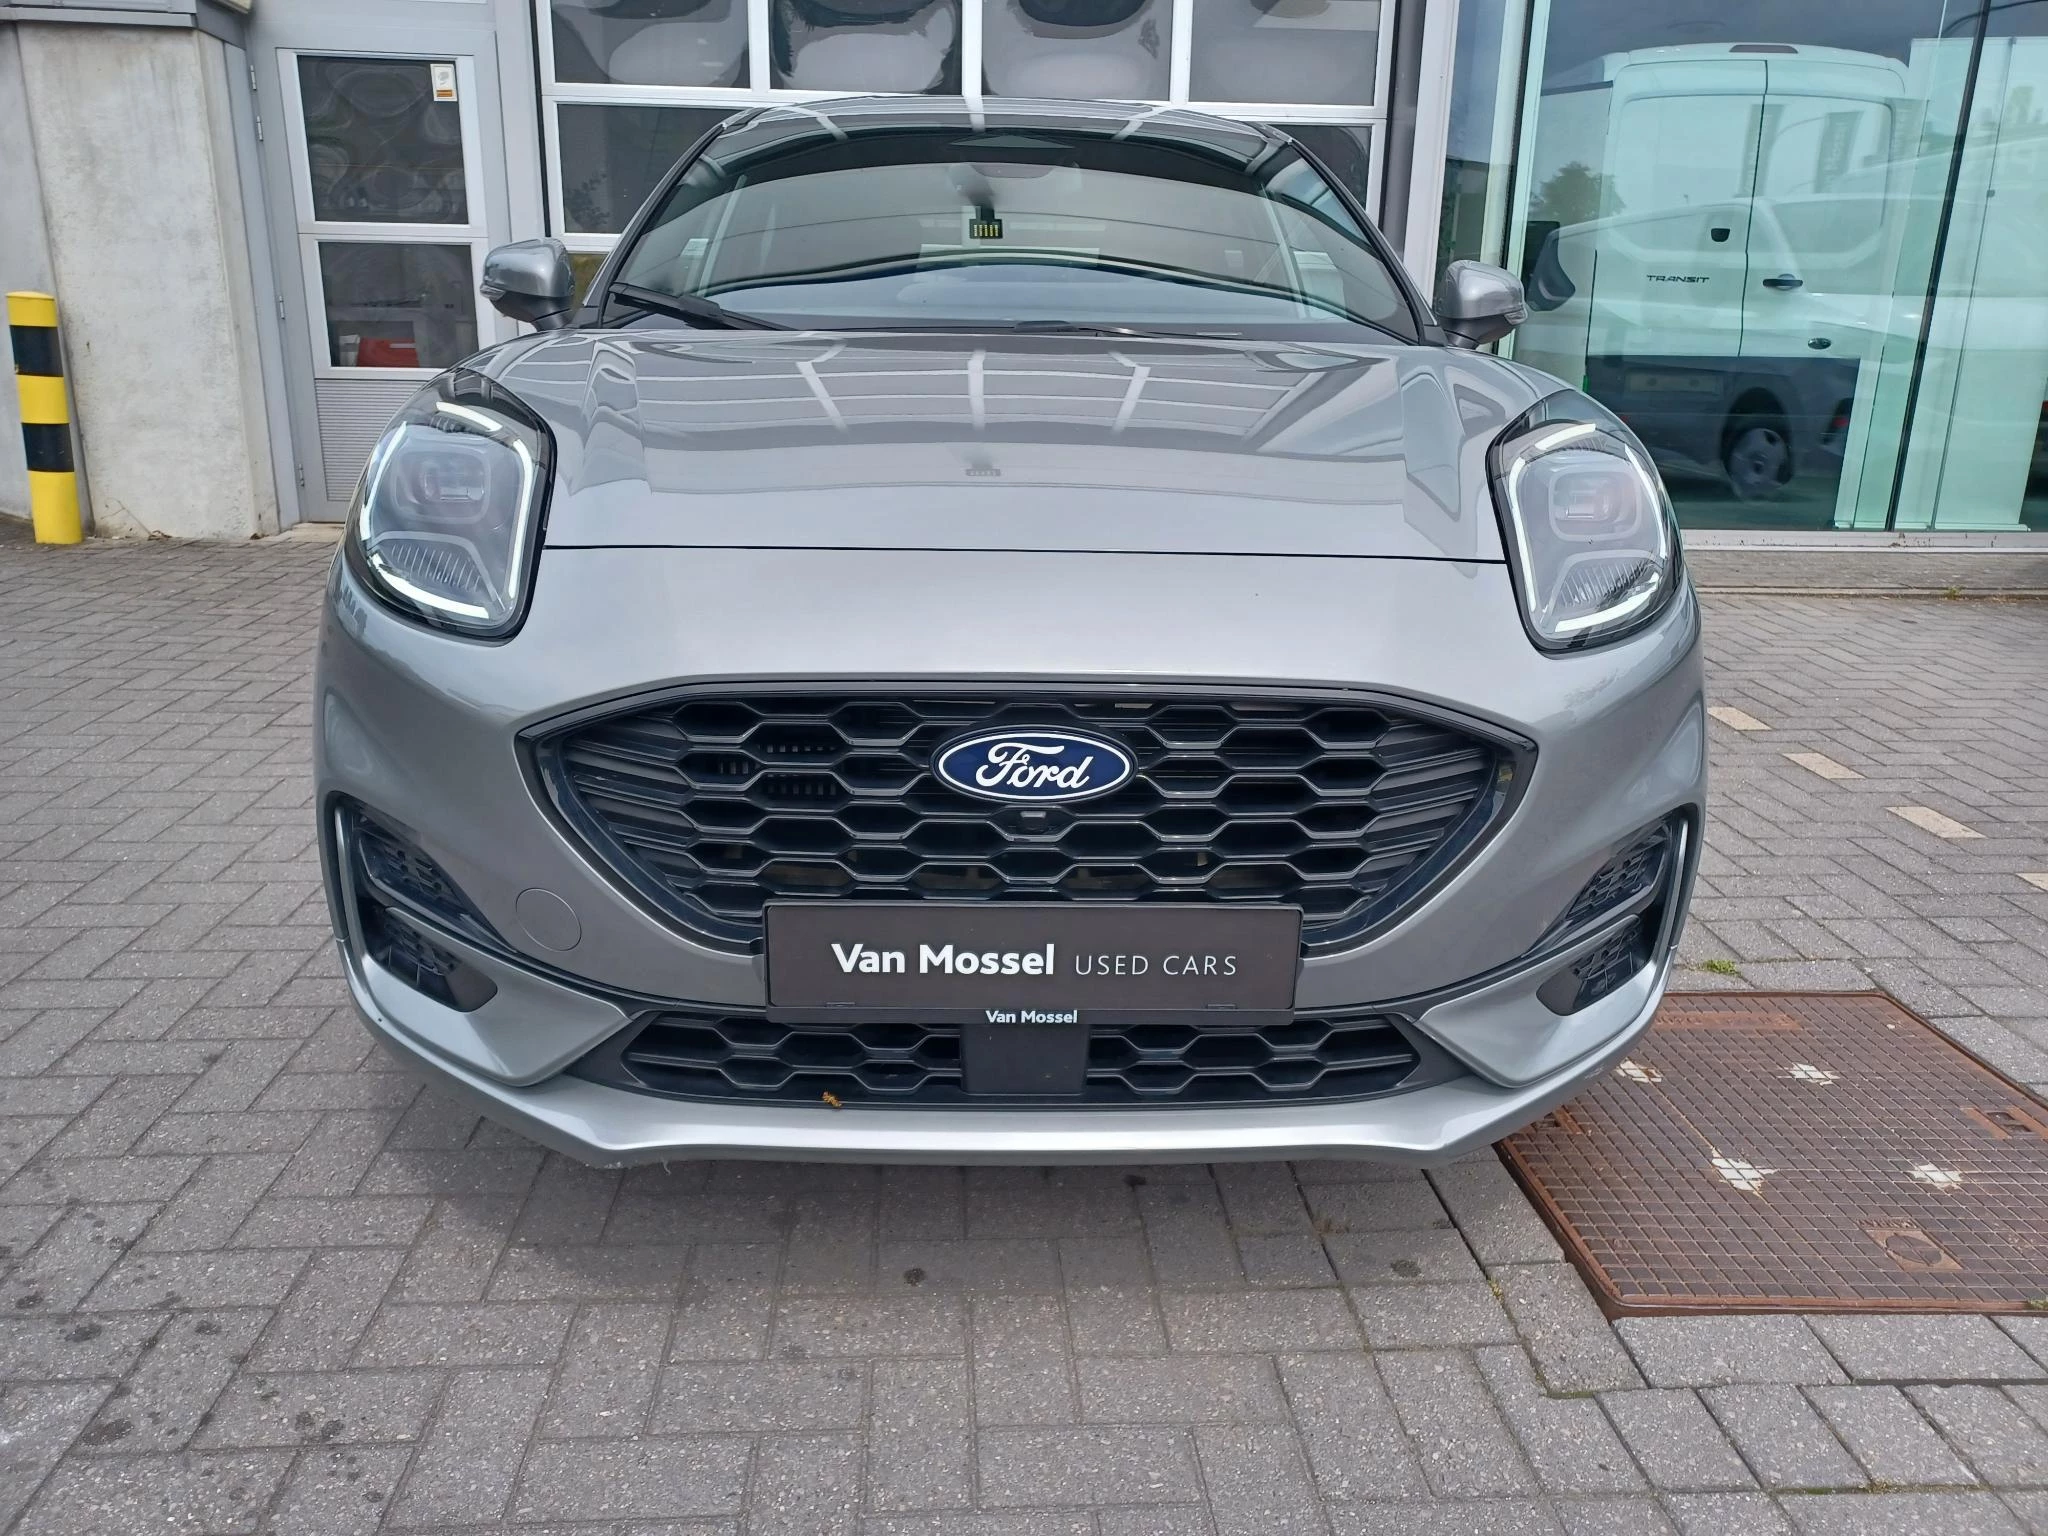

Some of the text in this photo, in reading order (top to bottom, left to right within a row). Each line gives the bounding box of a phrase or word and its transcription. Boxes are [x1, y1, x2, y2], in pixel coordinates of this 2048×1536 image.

[1646, 274, 1710, 284] TRANSIT
[975, 742, 1094, 789] Ford
[831, 943, 1237, 976] Van Mossel USED CARS
[985, 1009, 1078, 1024] Van Mossel
